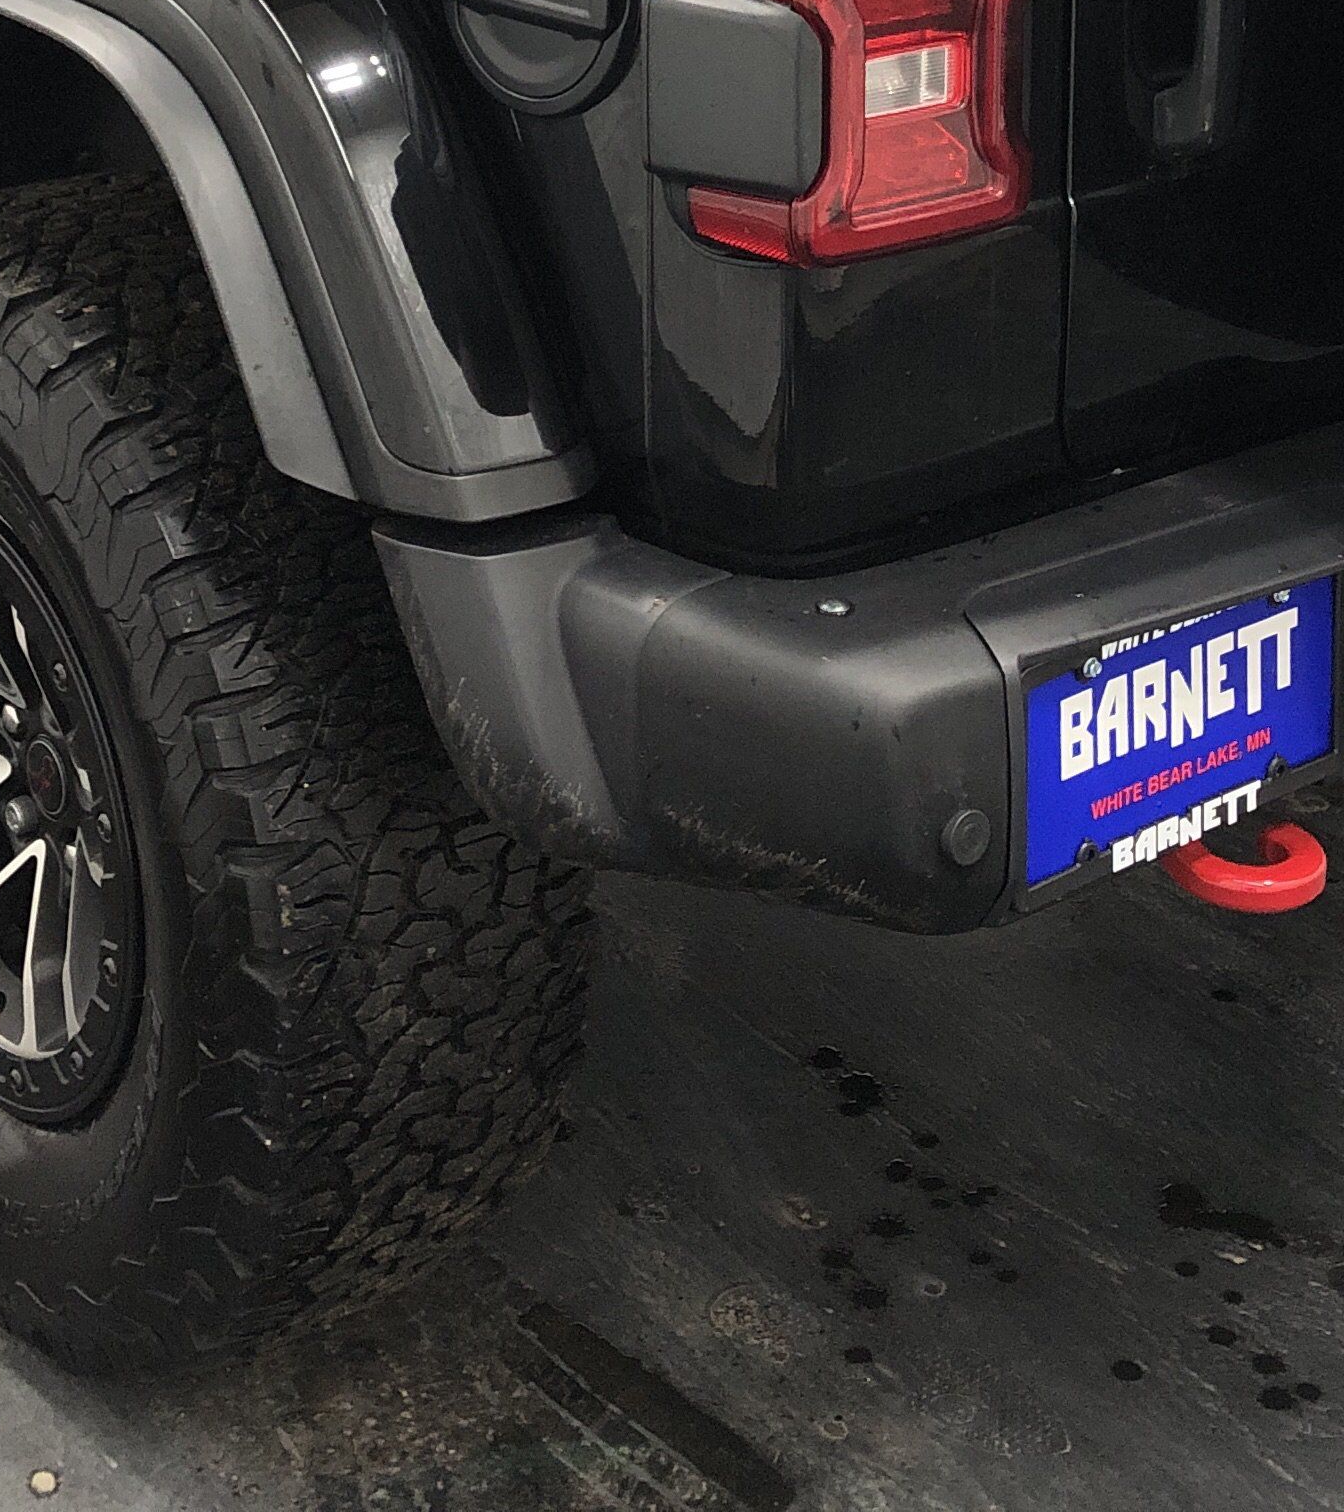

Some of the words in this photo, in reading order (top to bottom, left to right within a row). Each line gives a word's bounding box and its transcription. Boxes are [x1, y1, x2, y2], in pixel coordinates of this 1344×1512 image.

[1059, 606, 1299, 782] BARNETT
[1090, 780, 1144, 820] WHITE
[1146, 760, 1193, 796] BEAR
[1196, 740, 1244, 775] LAKE,
[1245, 726, 1272, 753] MN
[1112, 779, 1262, 874] BARNETT
